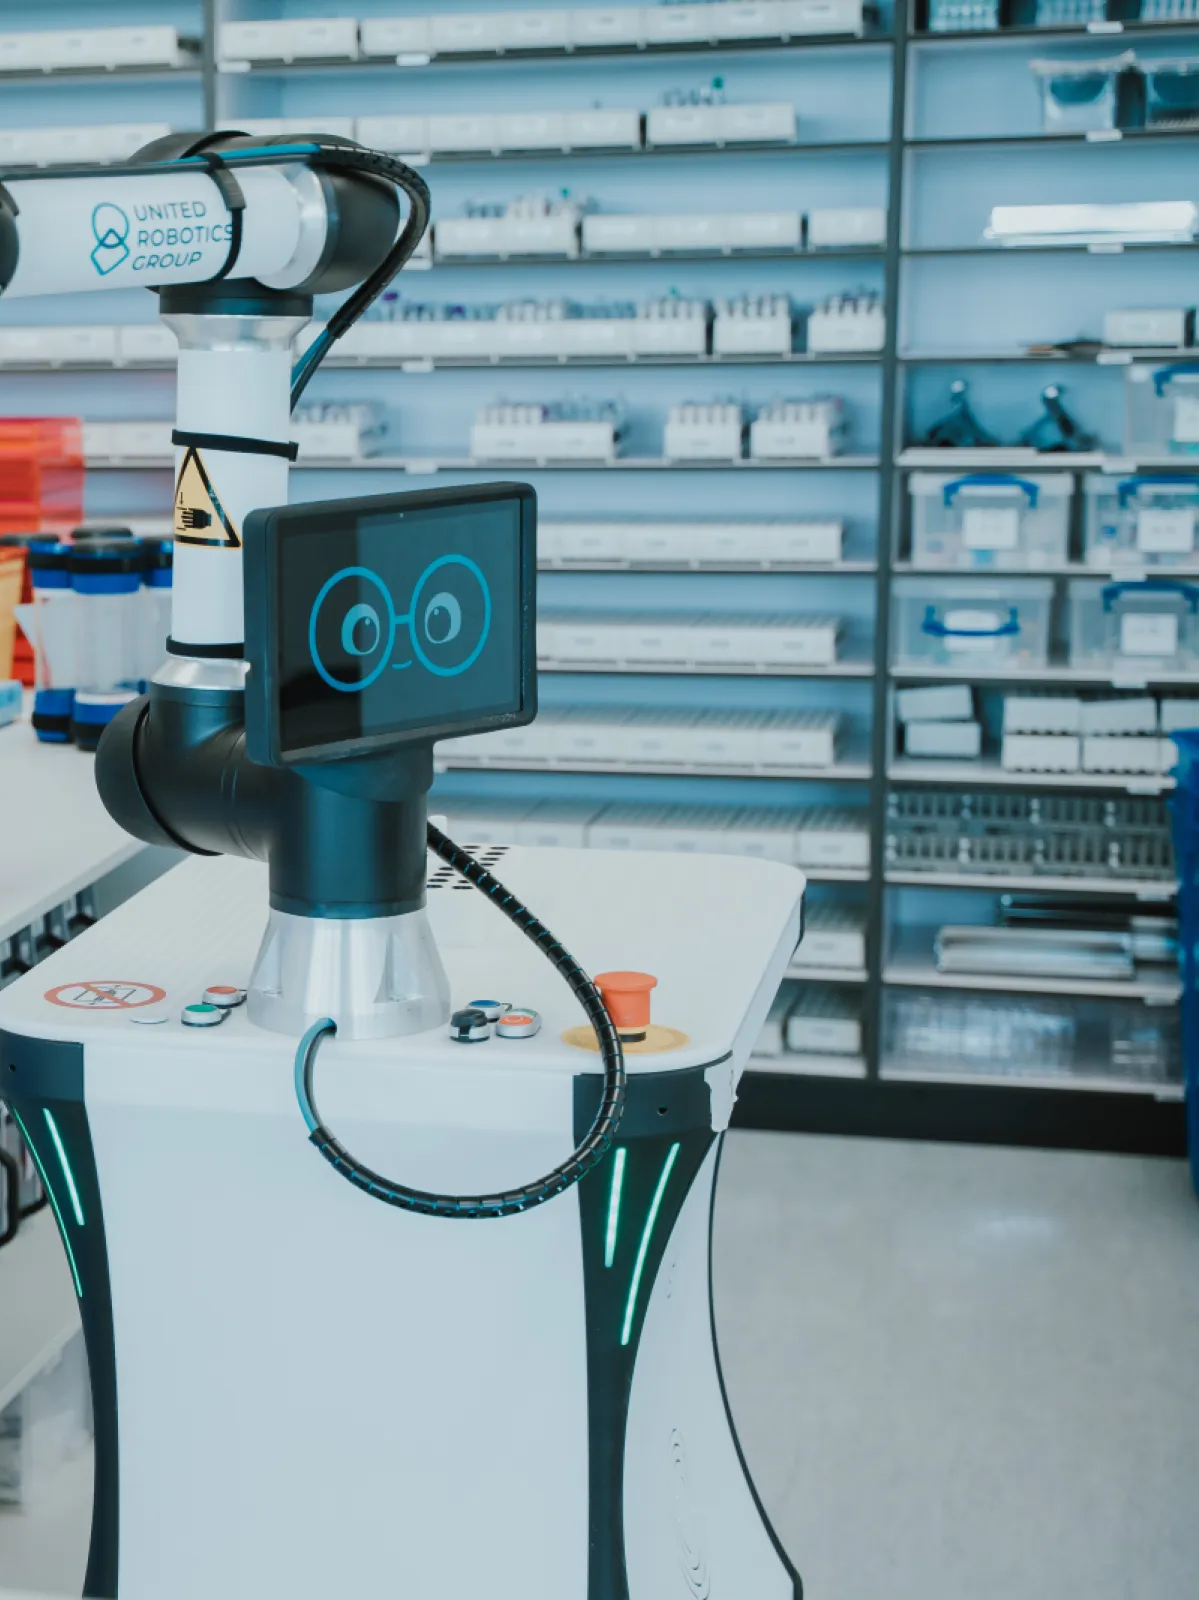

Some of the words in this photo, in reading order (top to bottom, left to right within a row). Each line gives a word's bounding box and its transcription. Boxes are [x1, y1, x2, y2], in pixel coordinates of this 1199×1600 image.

[133, 201, 206, 221] UNITED
[138, 224, 233, 247] ROBOTICS
[132, 251, 202, 270] GROUP
